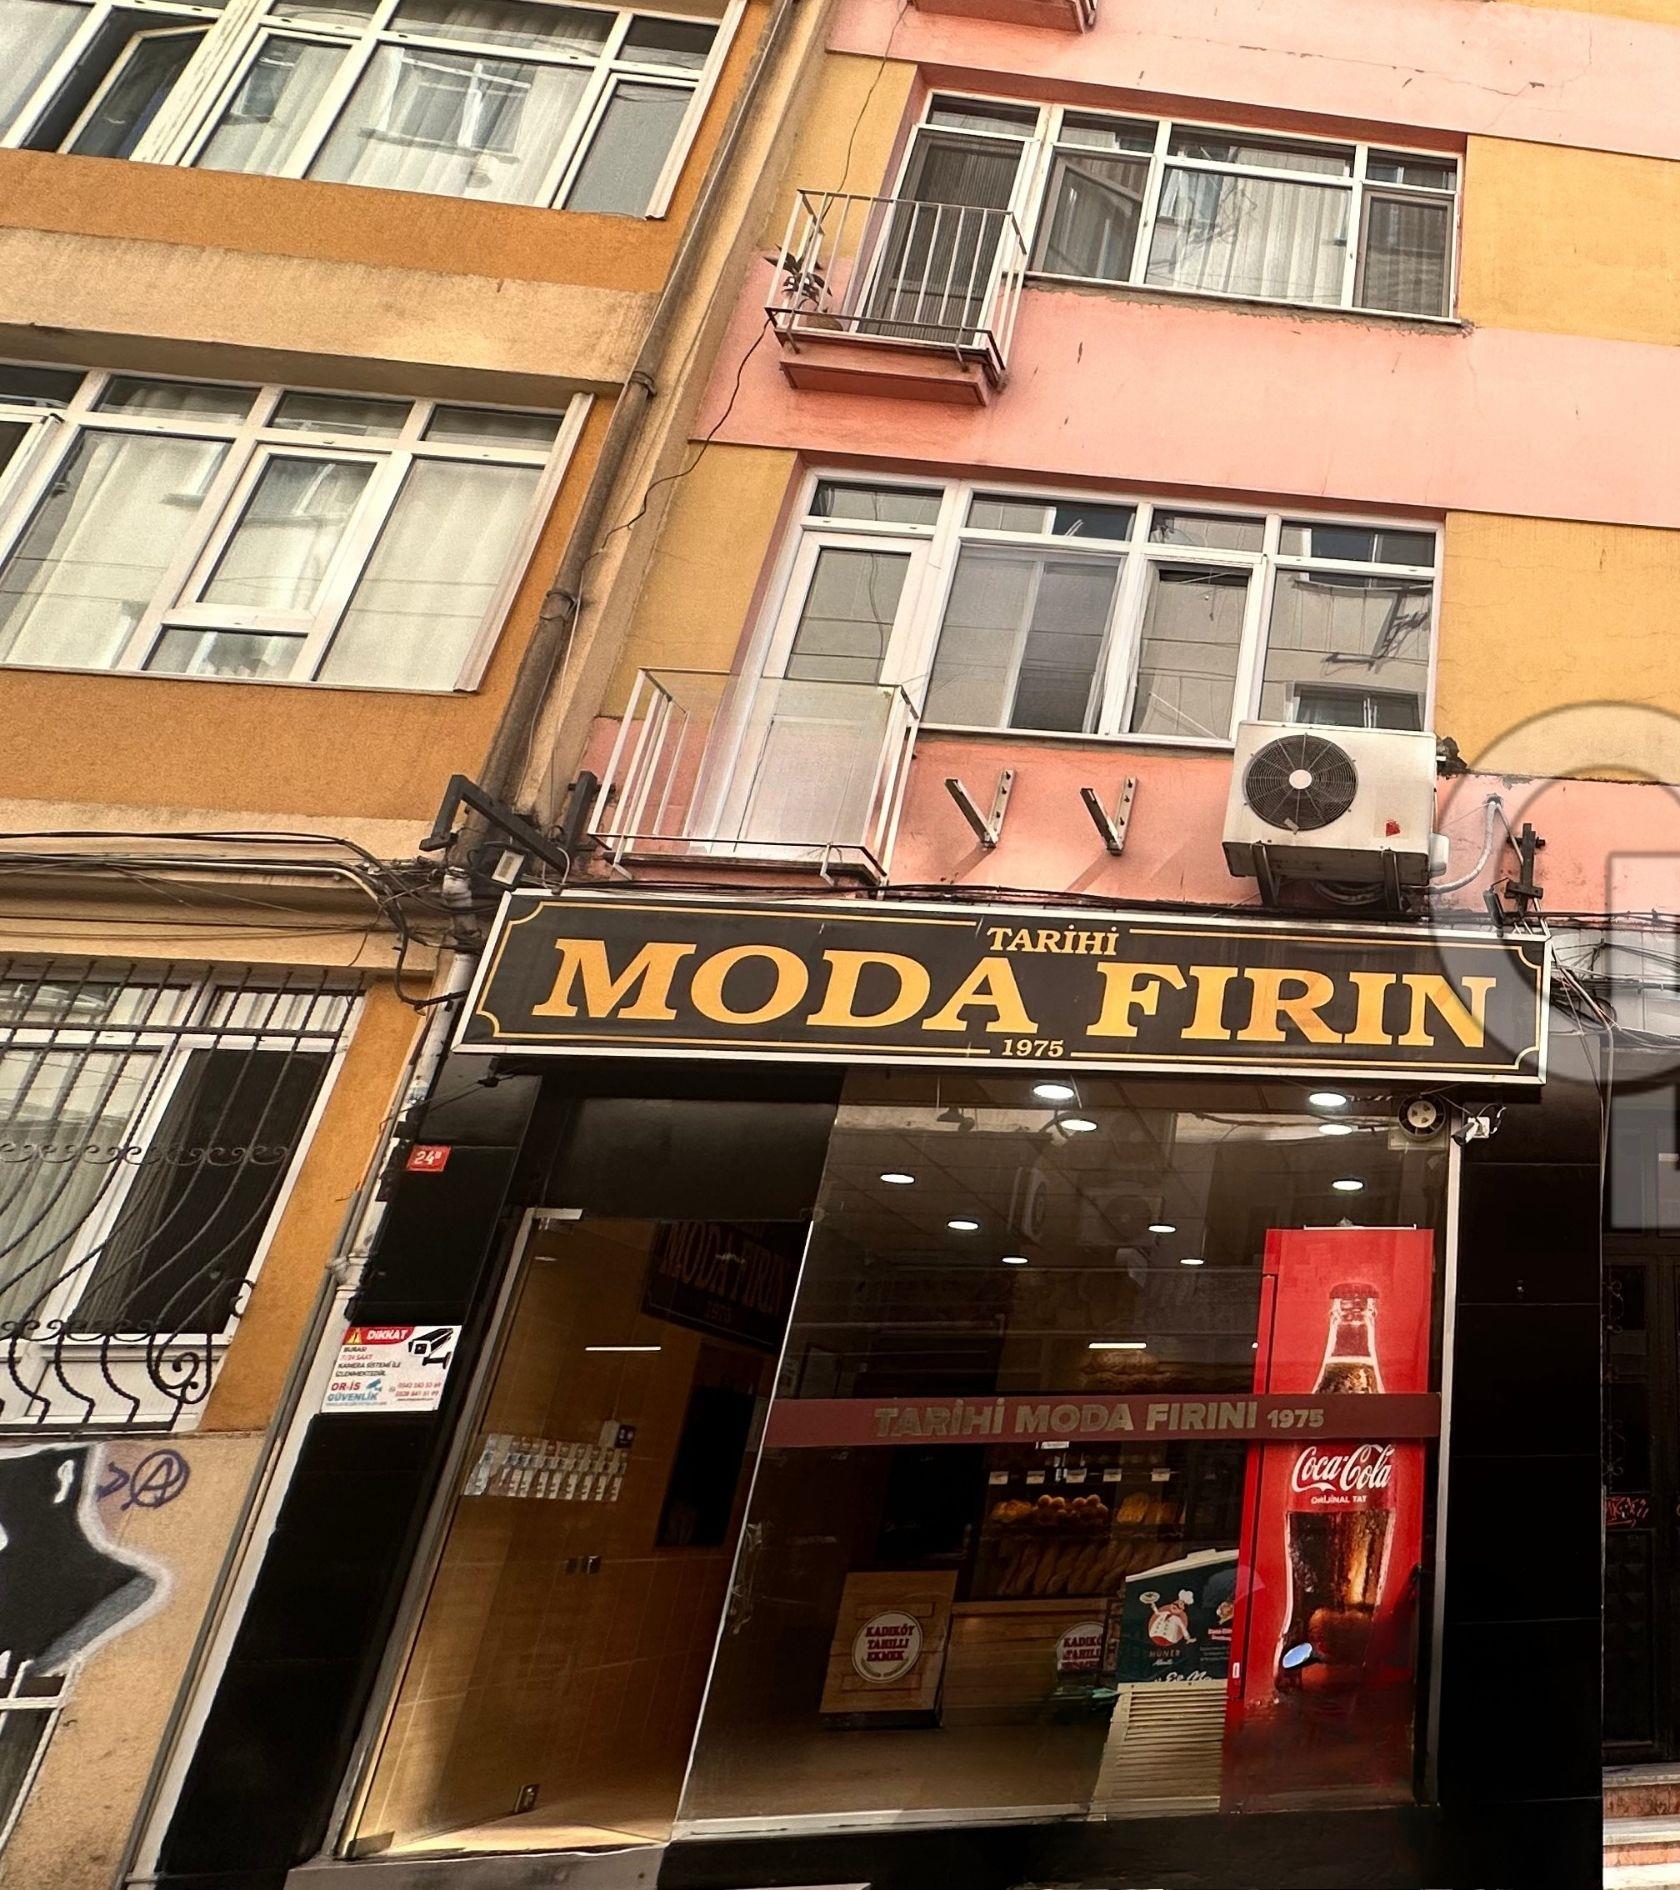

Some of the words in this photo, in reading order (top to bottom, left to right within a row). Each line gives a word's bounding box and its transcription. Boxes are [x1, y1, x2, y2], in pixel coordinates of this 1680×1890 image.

[987, 924, 1120, 956] TARİHİ
[531, 938, 1038, 1034] MODA
[1086, 962, 1497, 1048] FIRIN
[1002, 1039, 1064, 1058] 1975
[327, 1391, 378, 1402] GÜVENLİK
[874, 1397, 1006, 1437] TARİHİ
[1014, 1403, 1134, 1434] MODA
[1146, 1401, 1258, 1432] FIRINI
[1266, 1408, 1325, 1430] 1975
[1291, 1443, 1395, 1492] Coca-Cola
[1352, 1495, 1368, 1503] TAT
[866, 1623, 916, 1637] KADIKÖY
[867, 1638, 910, 1650] TAHILLI
[867, 1650, 905, 1662] EKMEK
